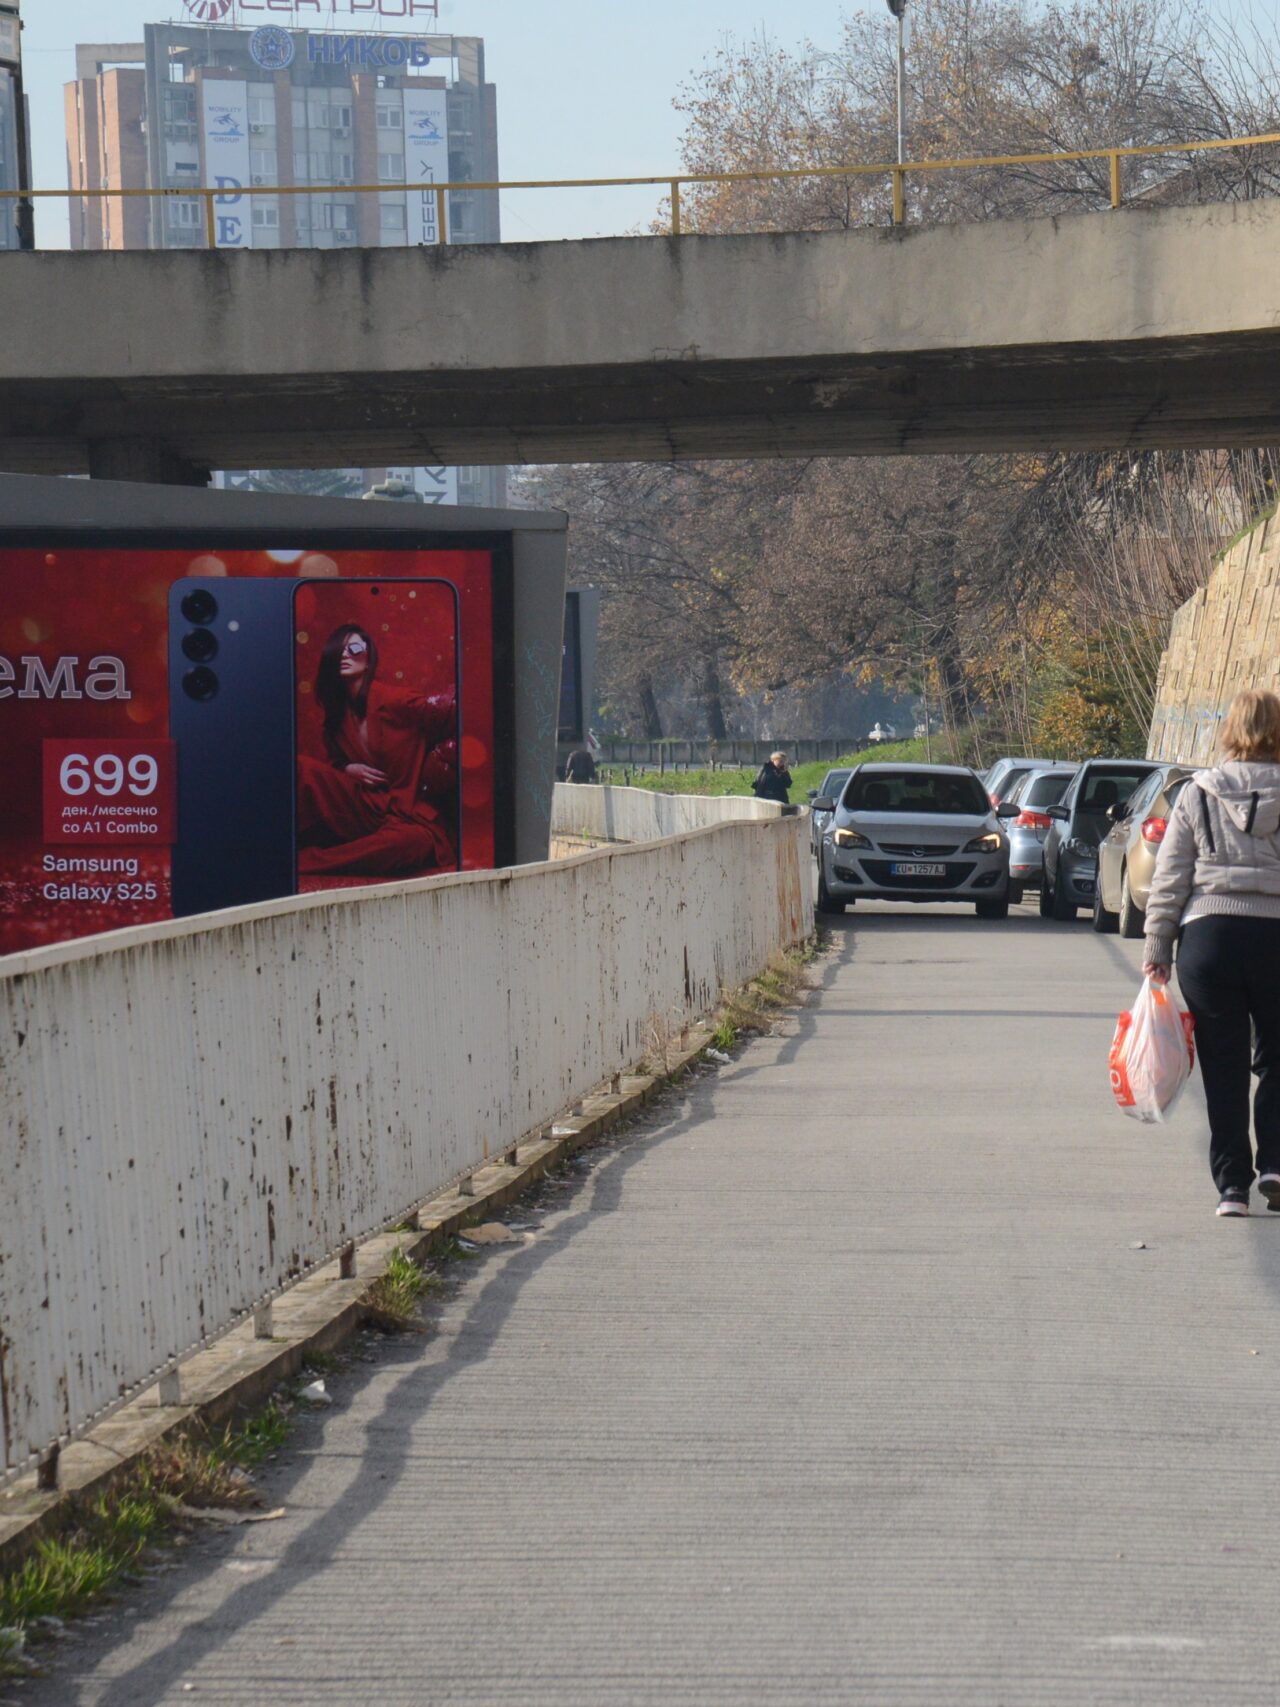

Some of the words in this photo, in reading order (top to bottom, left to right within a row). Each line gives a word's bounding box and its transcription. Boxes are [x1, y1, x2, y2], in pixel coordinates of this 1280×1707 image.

[307, 35, 431, 67] НИКОБ
[208, 105, 242, 113] MOBILITY
[421, 160, 435, 243] GEELY
[59, 753, 158, 796] 699
[61, 804, 158, 817] ден./месечно
[106, 820, 158, 834] Combo
[42, 855, 139, 876] Samsung
[43, 882, 112, 904] Galaxy
[117, 882, 158, 900] S25
